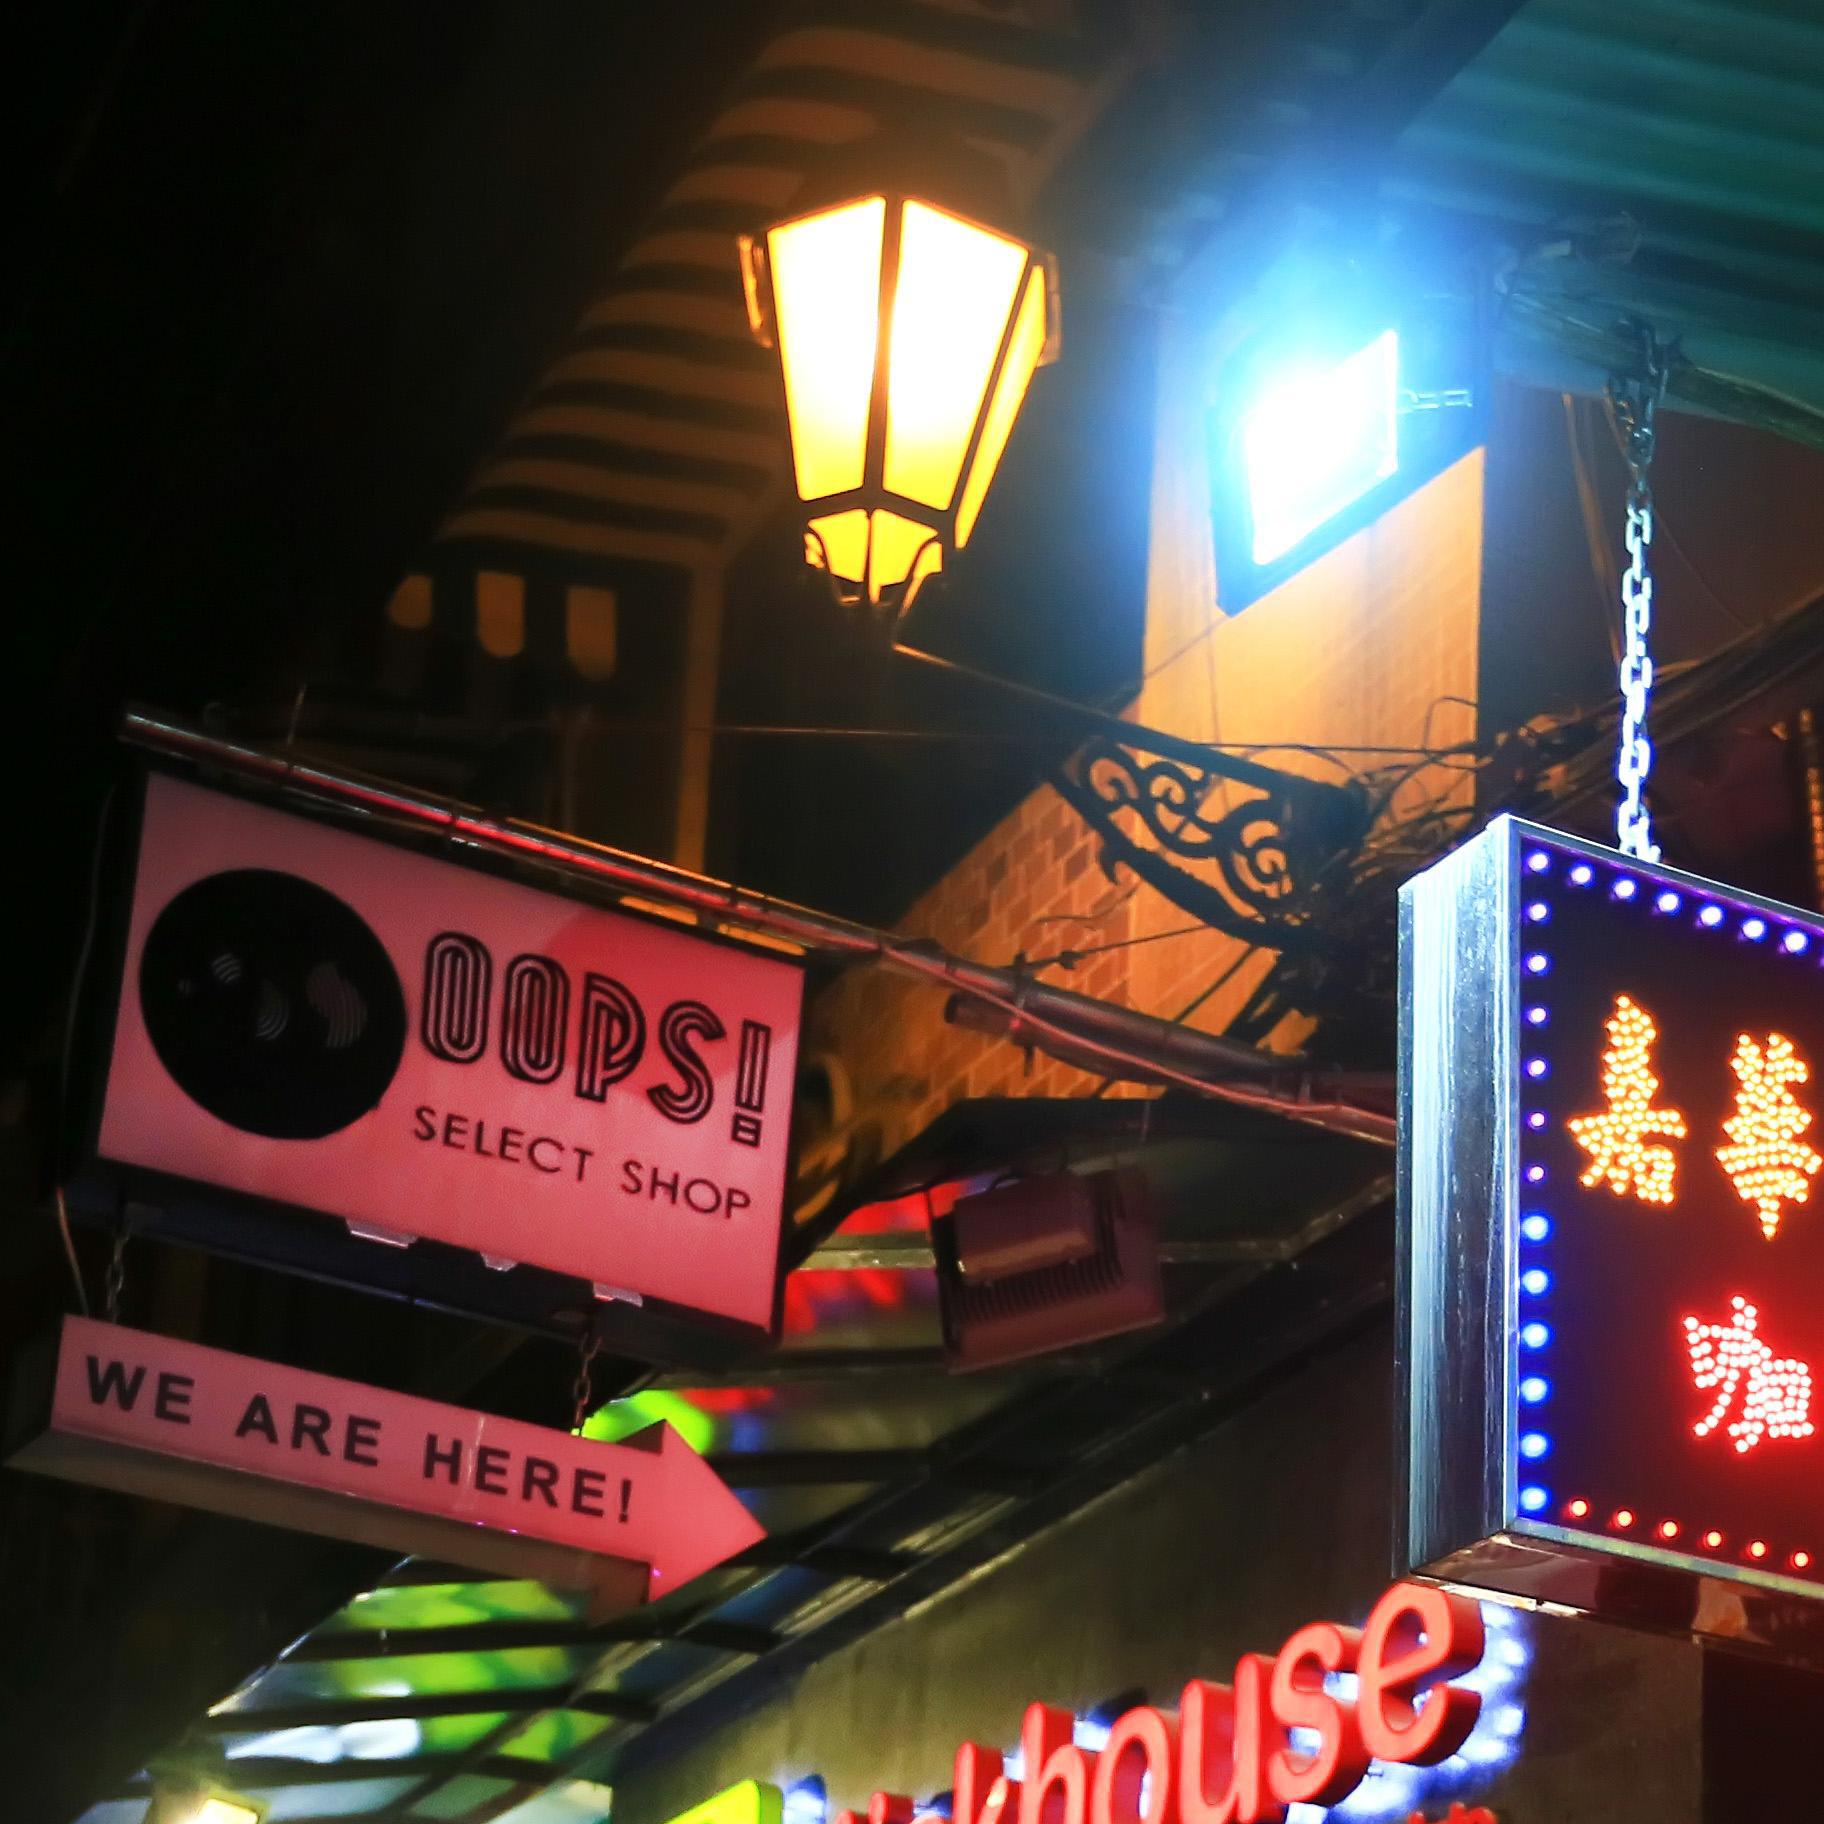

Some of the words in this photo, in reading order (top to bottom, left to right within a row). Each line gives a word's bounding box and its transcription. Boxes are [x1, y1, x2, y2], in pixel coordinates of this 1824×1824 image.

[419, 931, 772, 1148] OOPS!
[413, 1106, 594, 1184] SELECT
[620, 1158, 752, 1219] SHOP
[84, 1353, 194, 1426] WE
[235, 1393, 384, 1467] ARE
[422, 1433, 635, 1524] HERE!
